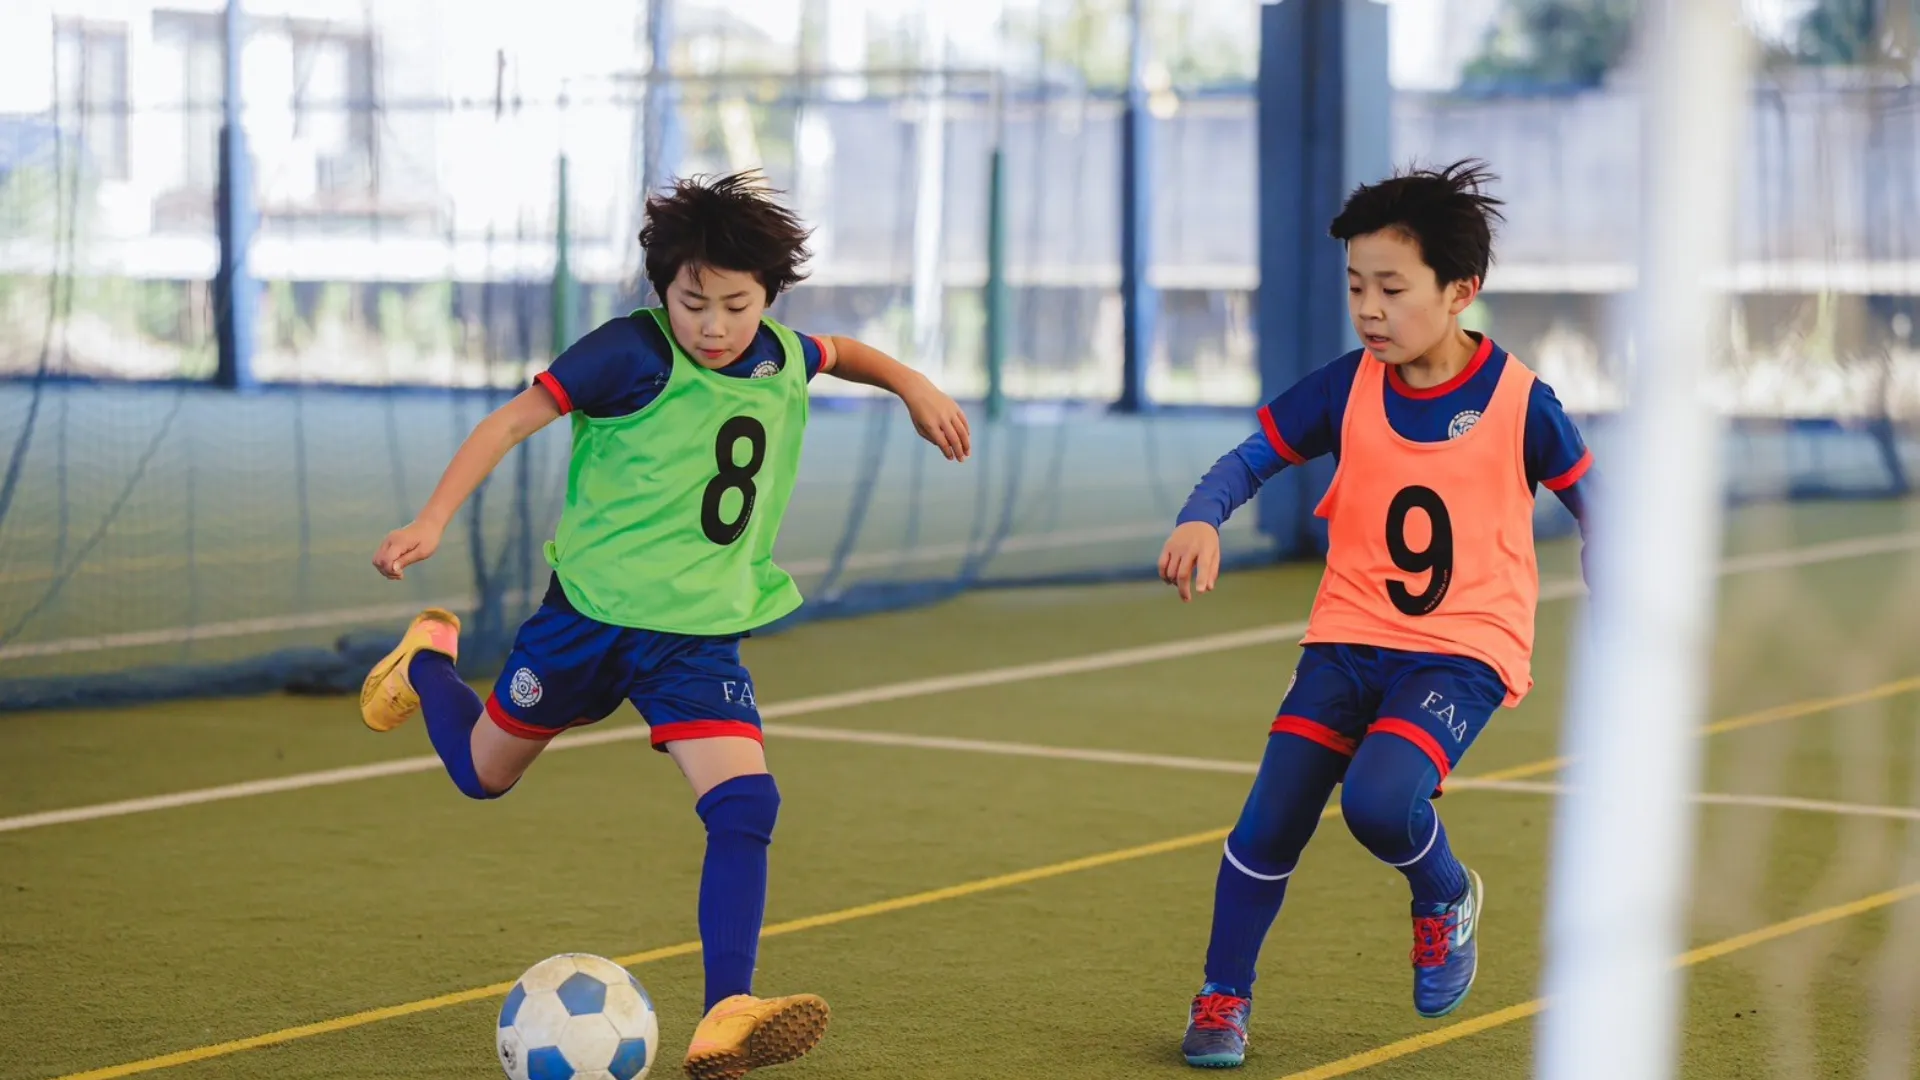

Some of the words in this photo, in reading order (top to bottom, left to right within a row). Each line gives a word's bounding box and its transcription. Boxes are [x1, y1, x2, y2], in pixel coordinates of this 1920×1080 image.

[701, 415, 766, 545] 8
[1385, 485, 1453, 616] 9
[1420, 690, 1467, 743] FAA
